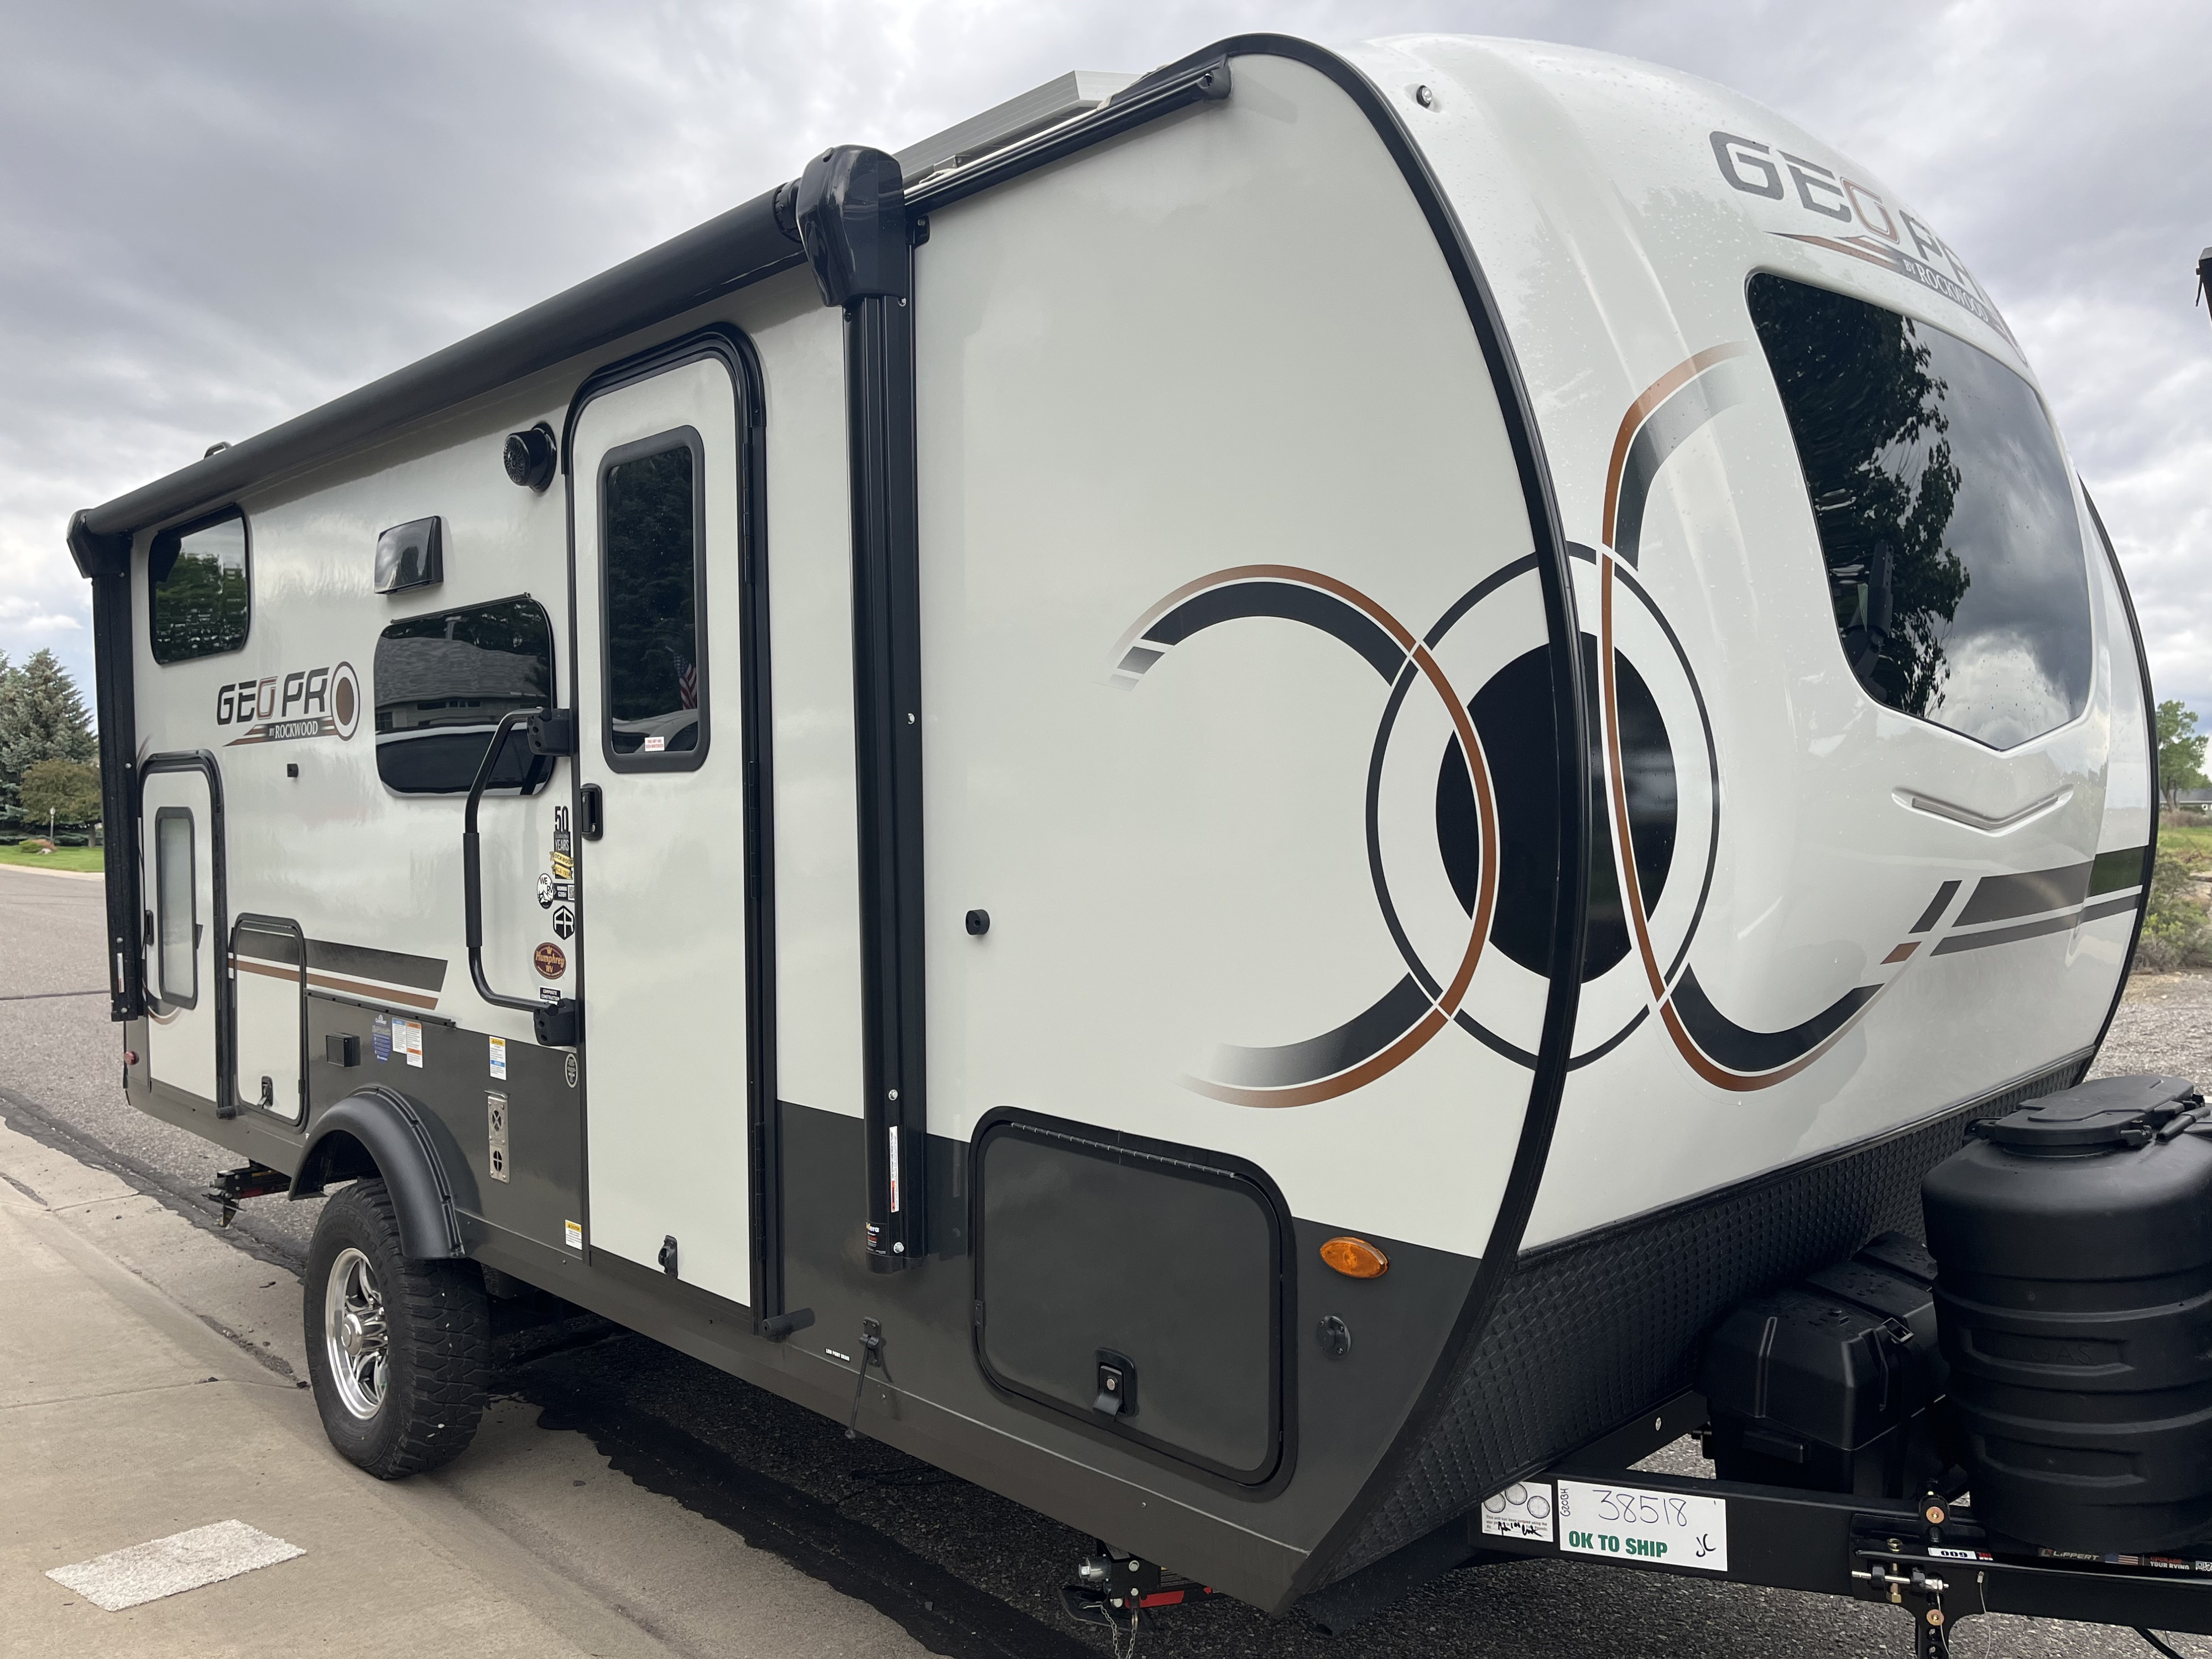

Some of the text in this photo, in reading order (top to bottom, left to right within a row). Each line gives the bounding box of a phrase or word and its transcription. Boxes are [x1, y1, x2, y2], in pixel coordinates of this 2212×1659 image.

[1709, 131, 1901, 244] GEO
[1902, 258, 1989, 322] BY ROCKWOOD
[217, 676, 278, 726] GEO
[275, 721, 319, 739] ROCKWOOD
[555, 805, 569, 832] 50
[555, 839, 570, 851] YEARS
[535, 950, 565, 968] Humphrey
[545, 965, 554, 973] RV
[1593, 1489, 1687, 1527] 38518
[1569, 1531, 1668, 1558] OK TO SHIP
[2053, 1551, 2100, 1561] LIPPERT
